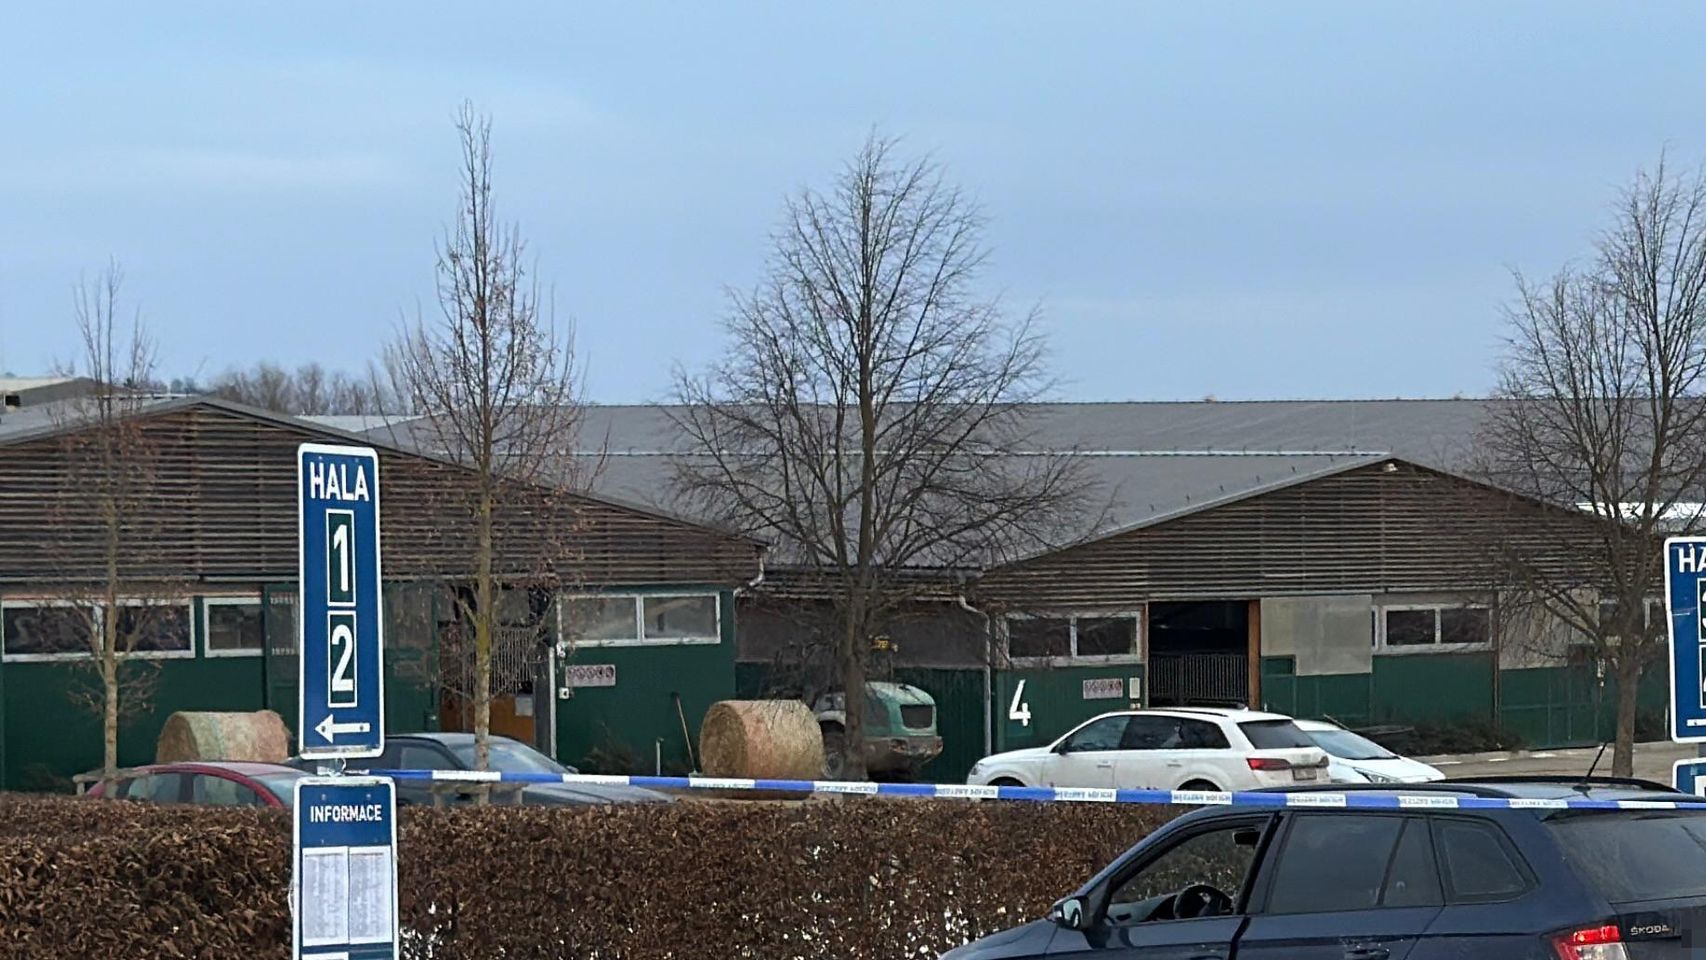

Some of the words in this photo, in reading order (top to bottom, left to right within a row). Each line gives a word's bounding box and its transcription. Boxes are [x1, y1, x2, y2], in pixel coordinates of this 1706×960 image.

[310, 462, 369, 501] HALA
[333, 524, 349, 591] 1
[331, 624, 354, 692] 2
[1009, 679, 1031, 726] 4
[310, 804, 382, 823] INFORMACE
